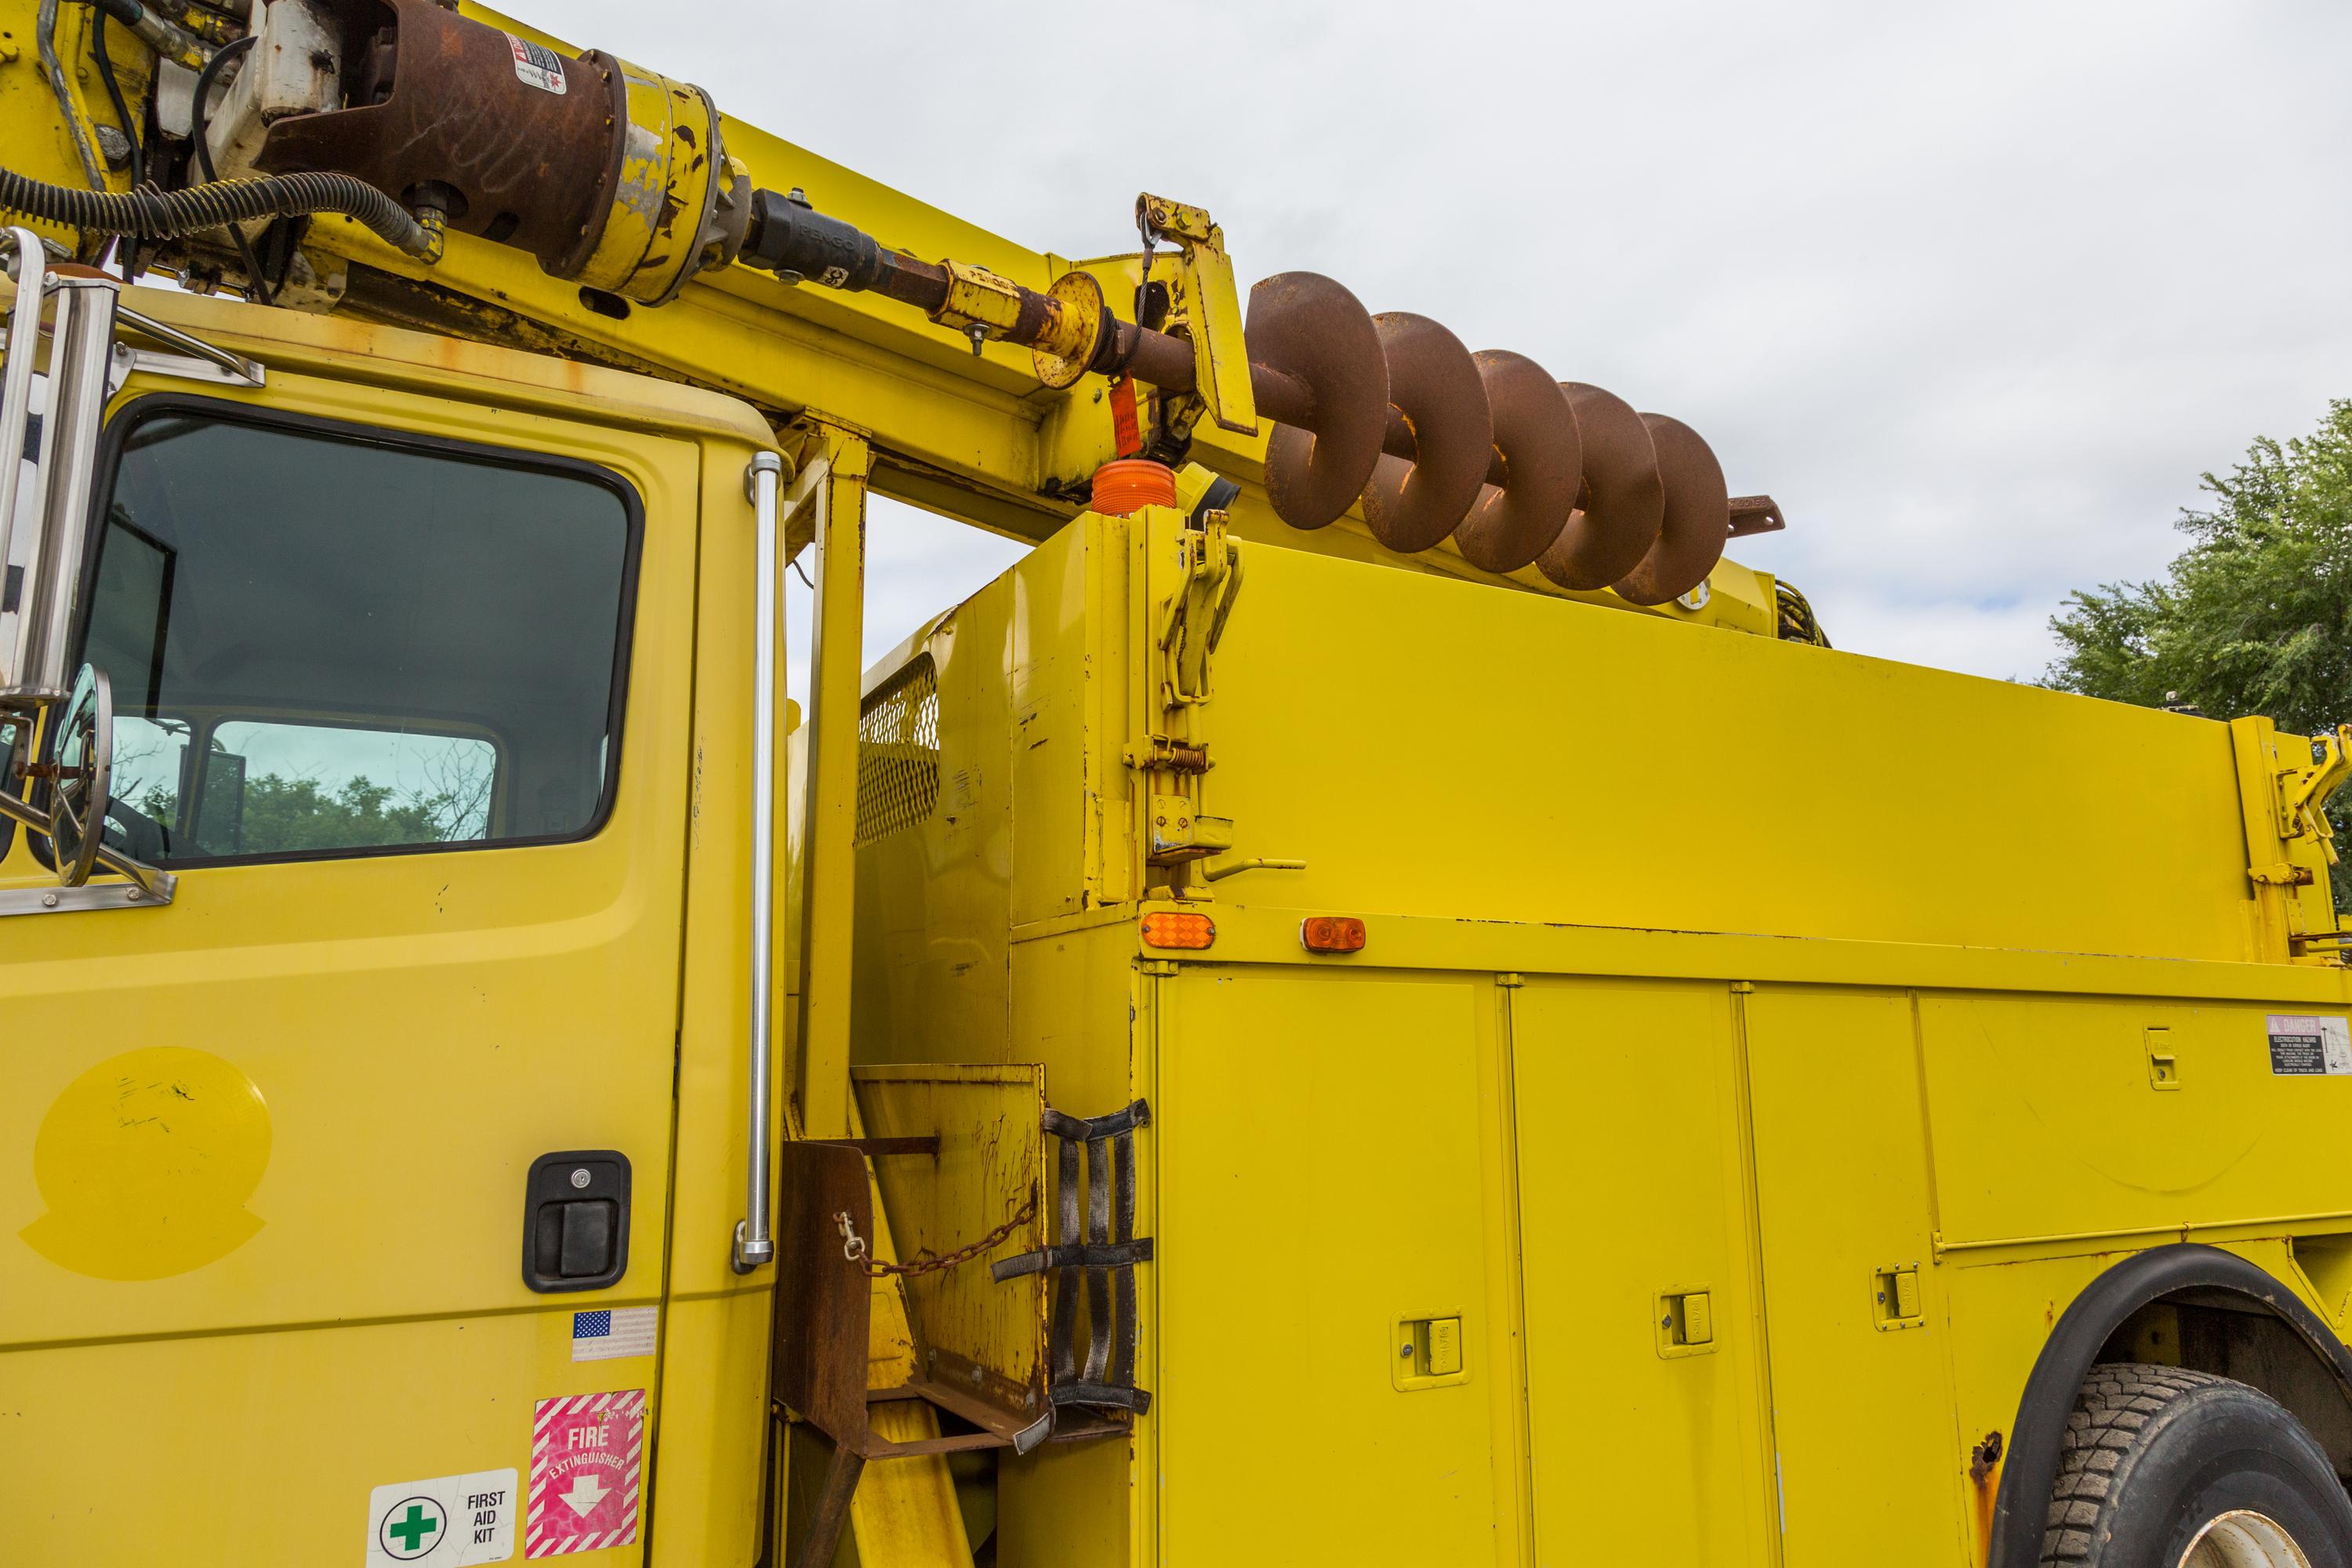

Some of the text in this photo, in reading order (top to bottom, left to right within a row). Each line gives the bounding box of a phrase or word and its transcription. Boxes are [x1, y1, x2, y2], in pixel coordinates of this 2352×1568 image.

[2283, 1018, 2316, 1033] DANGER
[568, 1425, 610, 1450] FIRE
[549, 1452, 625, 1479] EXTINGUISHER
[467, 1490, 506, 1510] FIRST
[474, 1510, 496, 1526] AID
[474, 1527, 495, 1544] KIT
